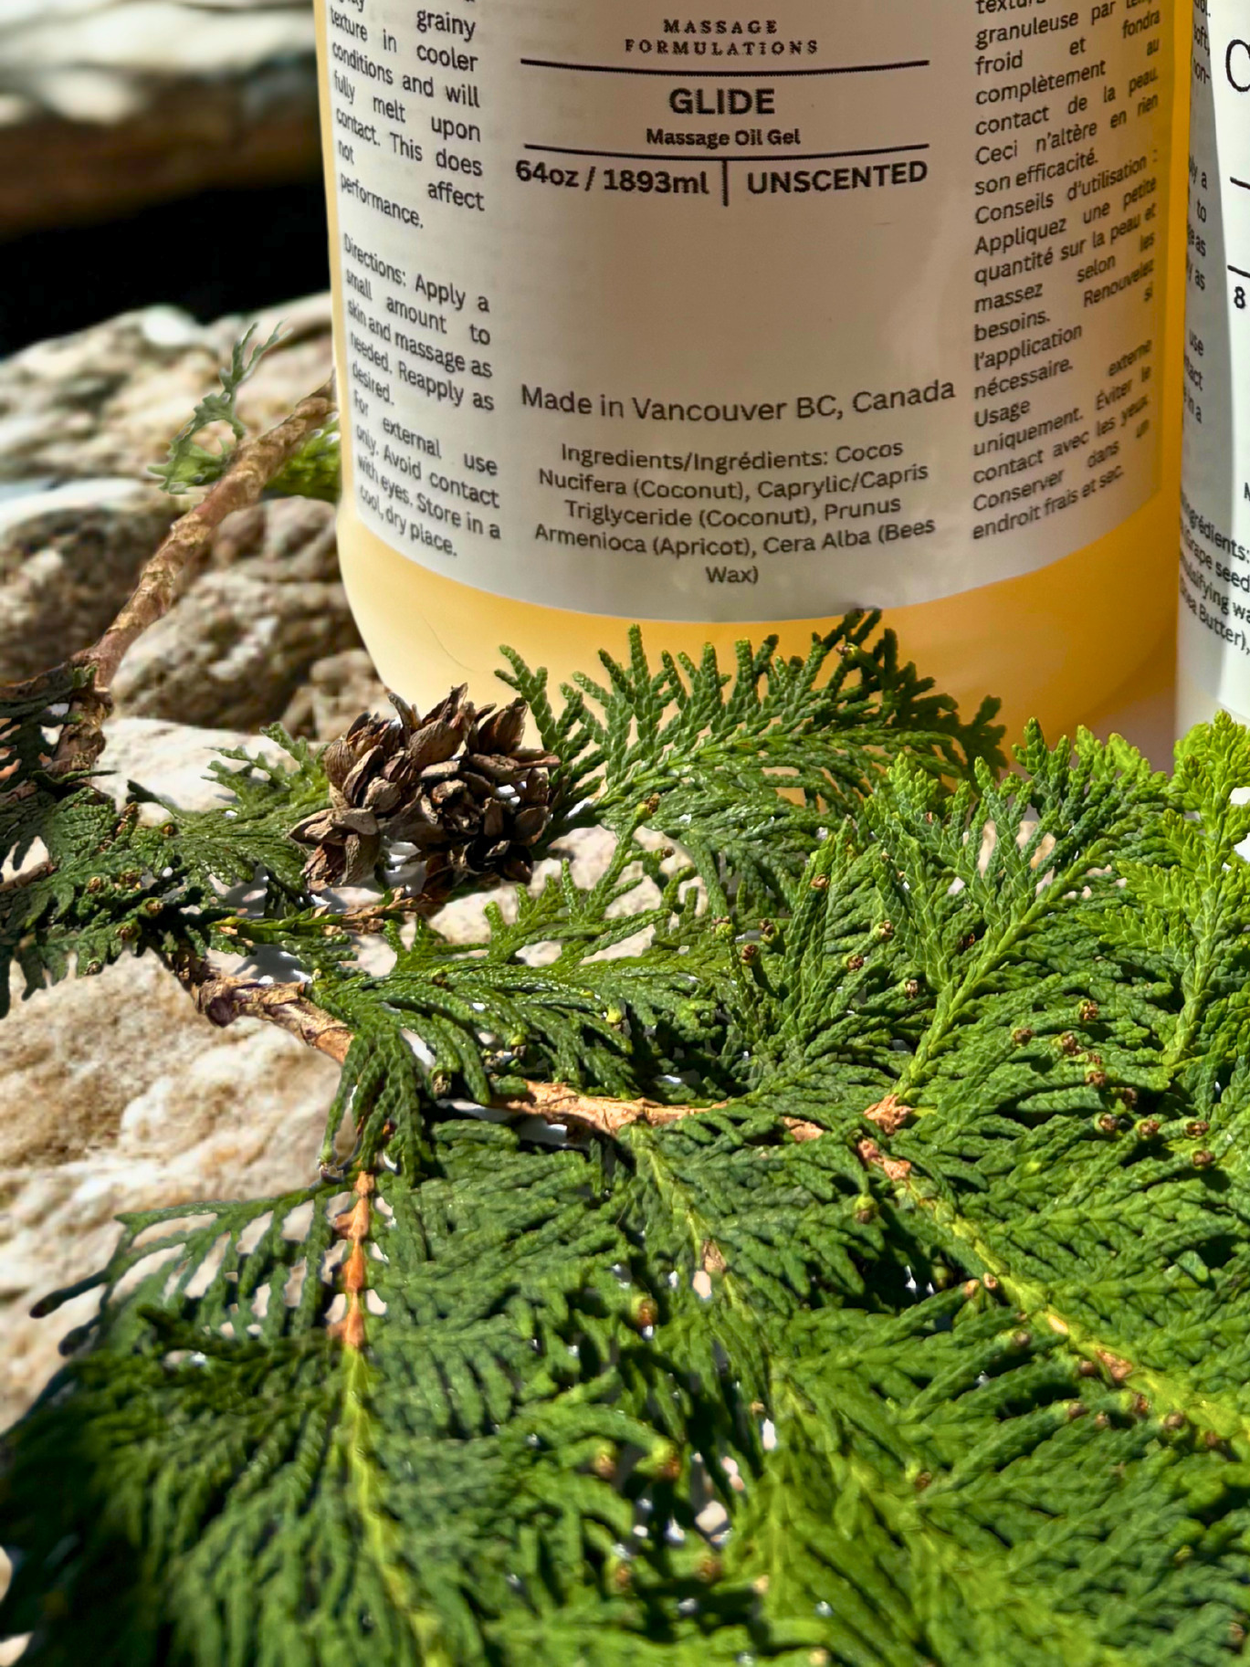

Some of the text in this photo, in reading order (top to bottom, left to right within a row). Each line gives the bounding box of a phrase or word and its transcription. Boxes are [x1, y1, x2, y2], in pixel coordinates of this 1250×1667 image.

[330, 8, 478, 72] texture in cooler
[416, 9, 476, 42] grainy
[664, 19, 777, 34] MASSAGE
[976, 9, 1078, 50] granuleuse
[1091, 1, 1116, 25] par
[976, 10, 1160, 75] froid et fondra
[626, 39, 818, 55] FORMULATIONS
[332, 40, 480, 108] conditions and will
[976, 39, 1159, 105] complètement au
[669, 88, 775, 115] GLIDE
[336, 105, 482, 176] contact. This does
[647, 129, 801, 149] Massage Oil Gel
[516, 160, 579, 187] 64oz
[604, 169, 709, 194] 1893ml
[748, 161, 928, 194] UNSCENTED
[344, 233, 490, 313] Directions: Apply a
[1234, 286, 1246, 309] 8
[522, 379, 956, 421] Made in Vancouver BC, Canada
[562, 442, 903, 475] Ingredients/Ingrédients: Cocos
[539, 464, 928, 503] Nucifera (Coconut), Caprylic/Capris
[564, 497, 901, 529] Triglyceride (Coconut), Prunus
[535, 519, 936, 559] Armenioca (Apricot), Cera Alba (Bees
[706, 566, 758, 584] Wax)
[1200, 605, 1250, 655] Butter),
